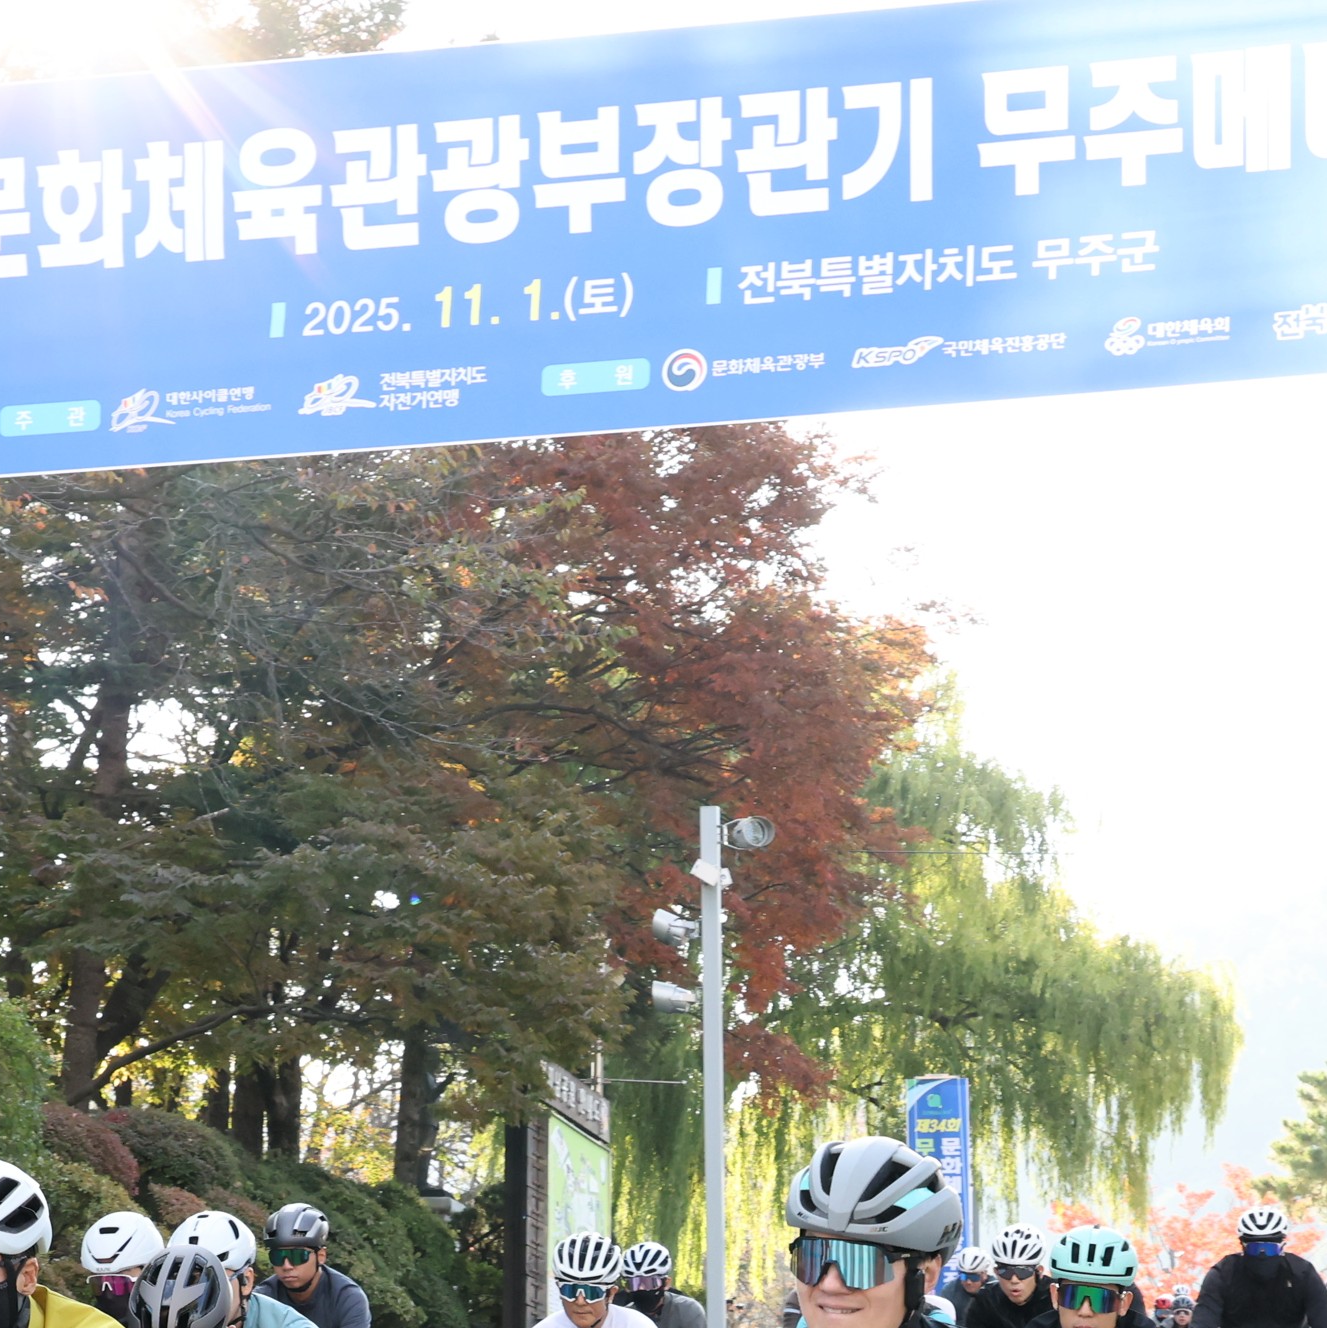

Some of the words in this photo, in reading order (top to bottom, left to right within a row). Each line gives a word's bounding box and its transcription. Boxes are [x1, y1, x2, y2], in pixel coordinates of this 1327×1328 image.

[737, 242, 1017, 306] 전북특별자치도
[1031, 229, 1158, 281] 무주군
[301, 297, 412, 338] 2025.
[433, 284, 501, 329] 11.
[522, 270, 635, 323] 1.(토)
[1147, 316, 1231, 338] 대한체육회
[853, 347, 918, 367] KSPO
[941, 332, 1068, 358] 국민체육진흥공단
[711, 352, 826, 377] 문화체육관광부
[379, 366, 488, 391] 전북특별자치도
[165, 386, 255, 407] 대한사이클연맹
[378, 388, 460, 412] 자전거연맹
[165, 407, 191, 420] Korea
[192, 405, 225, 419] Cycling
[226, 402, 272, 415] Federation
[915, 1117, 962, 1133] 제34회
